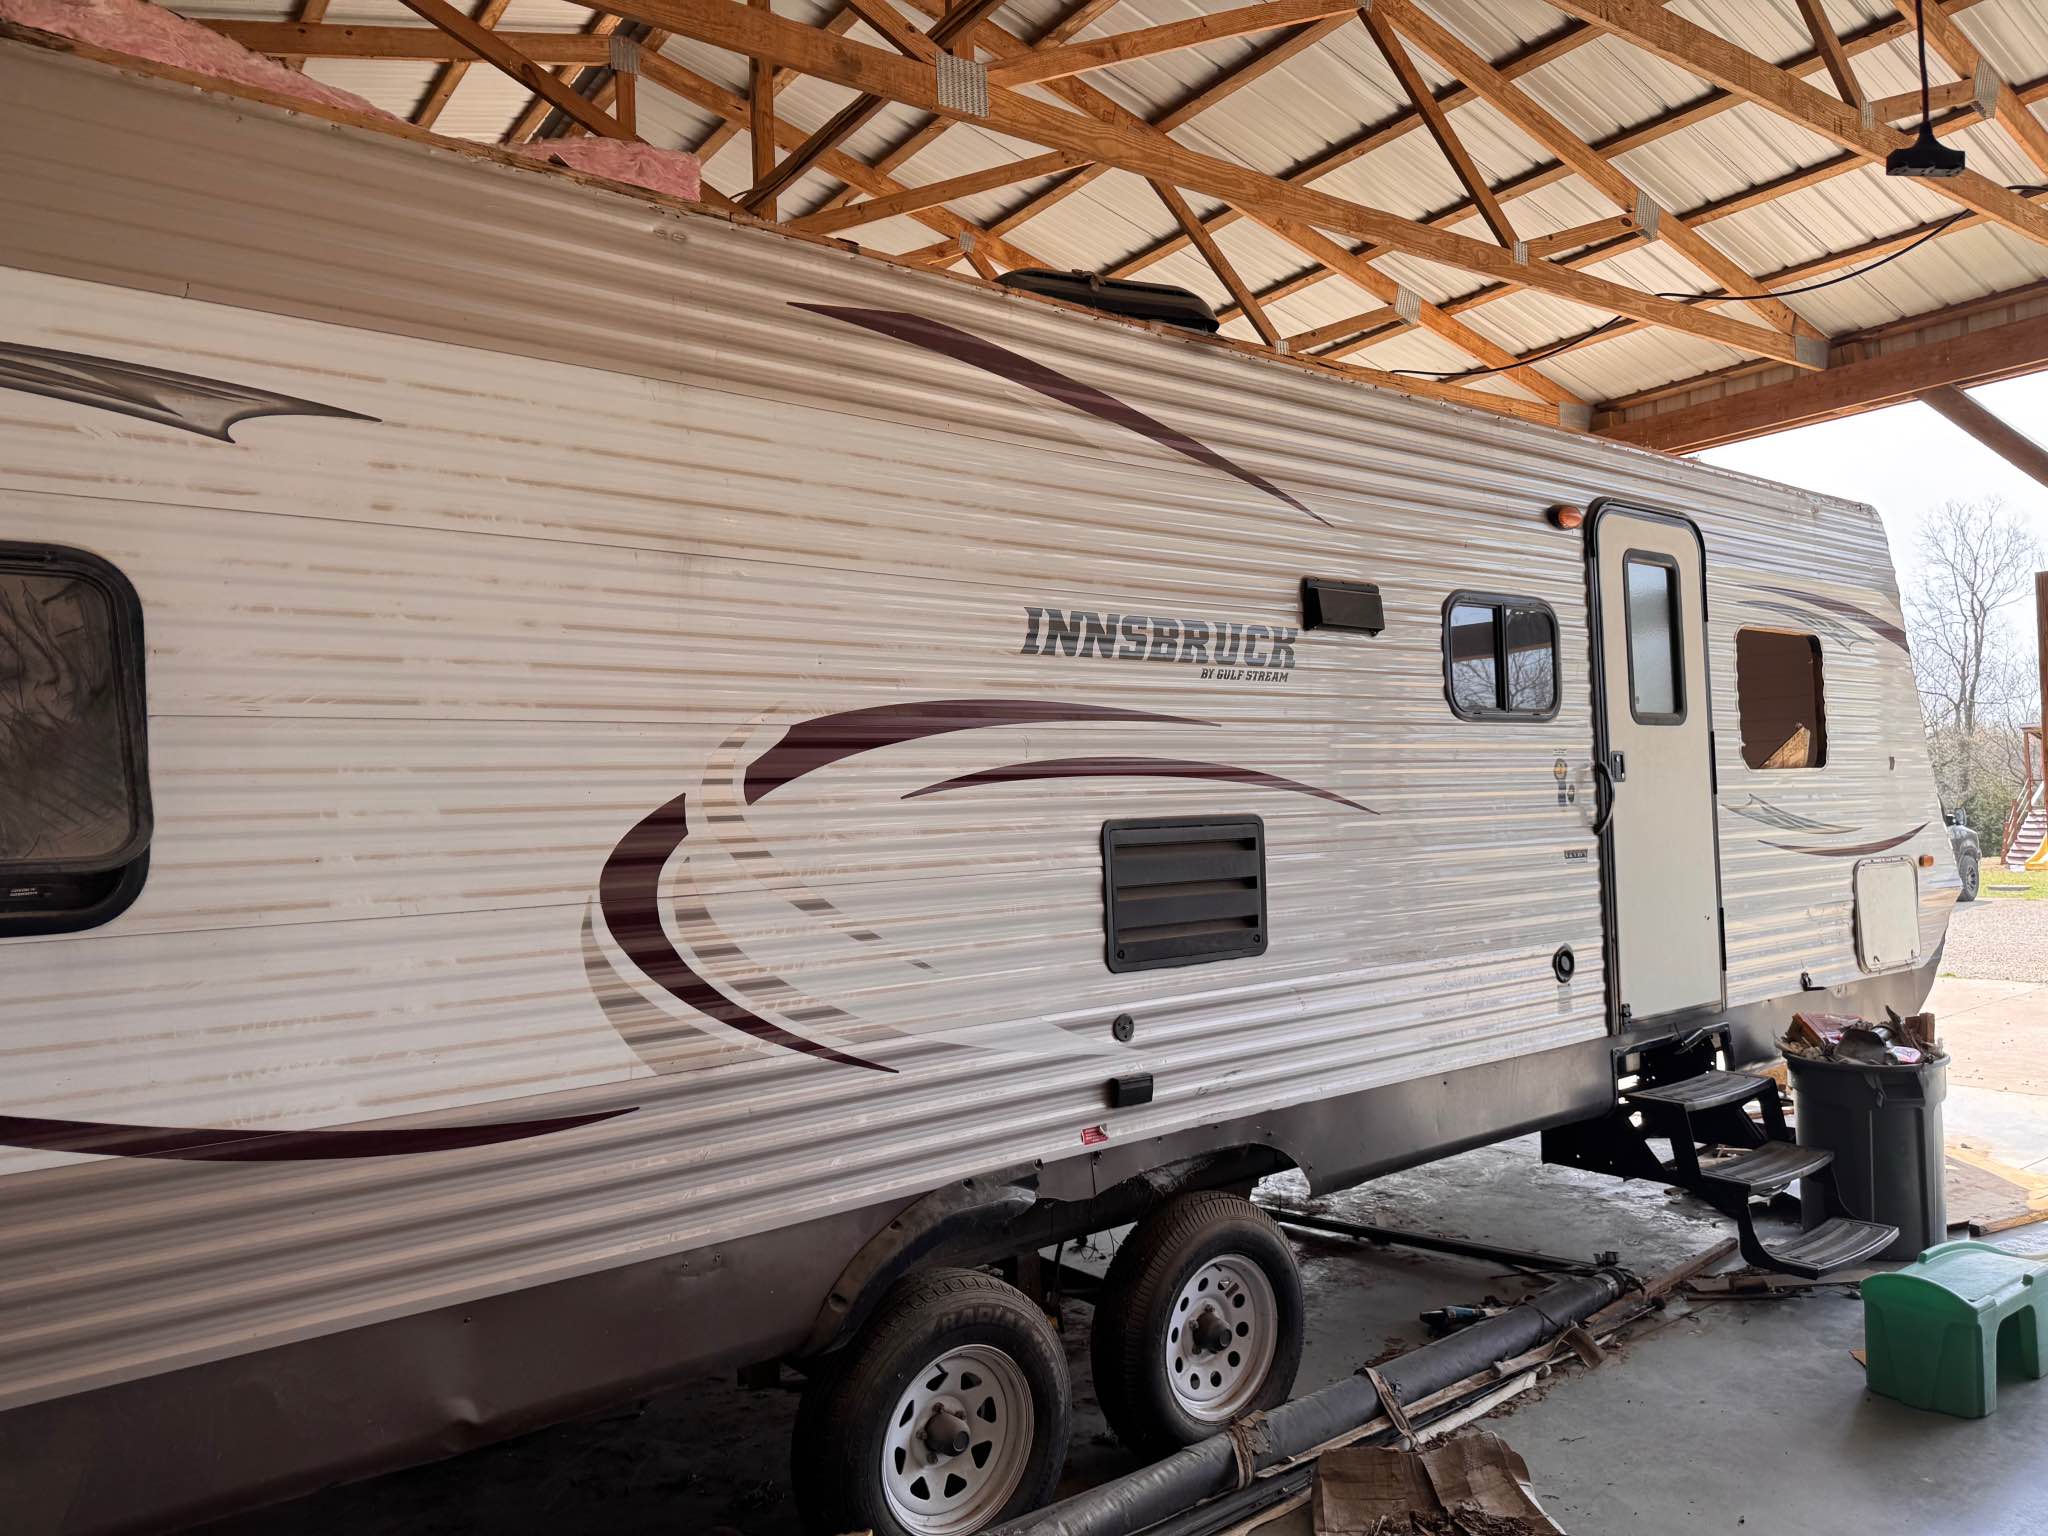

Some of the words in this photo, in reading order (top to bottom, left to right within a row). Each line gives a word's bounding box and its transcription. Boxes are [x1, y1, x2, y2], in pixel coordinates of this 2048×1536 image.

[1020, 607, 1299, 668] INNSBRUCK
[1200, 667, 1215, 680] BY
[1216, 668, 1244, 681] GULF
[1245, 670, 1289, 682] STREAM
